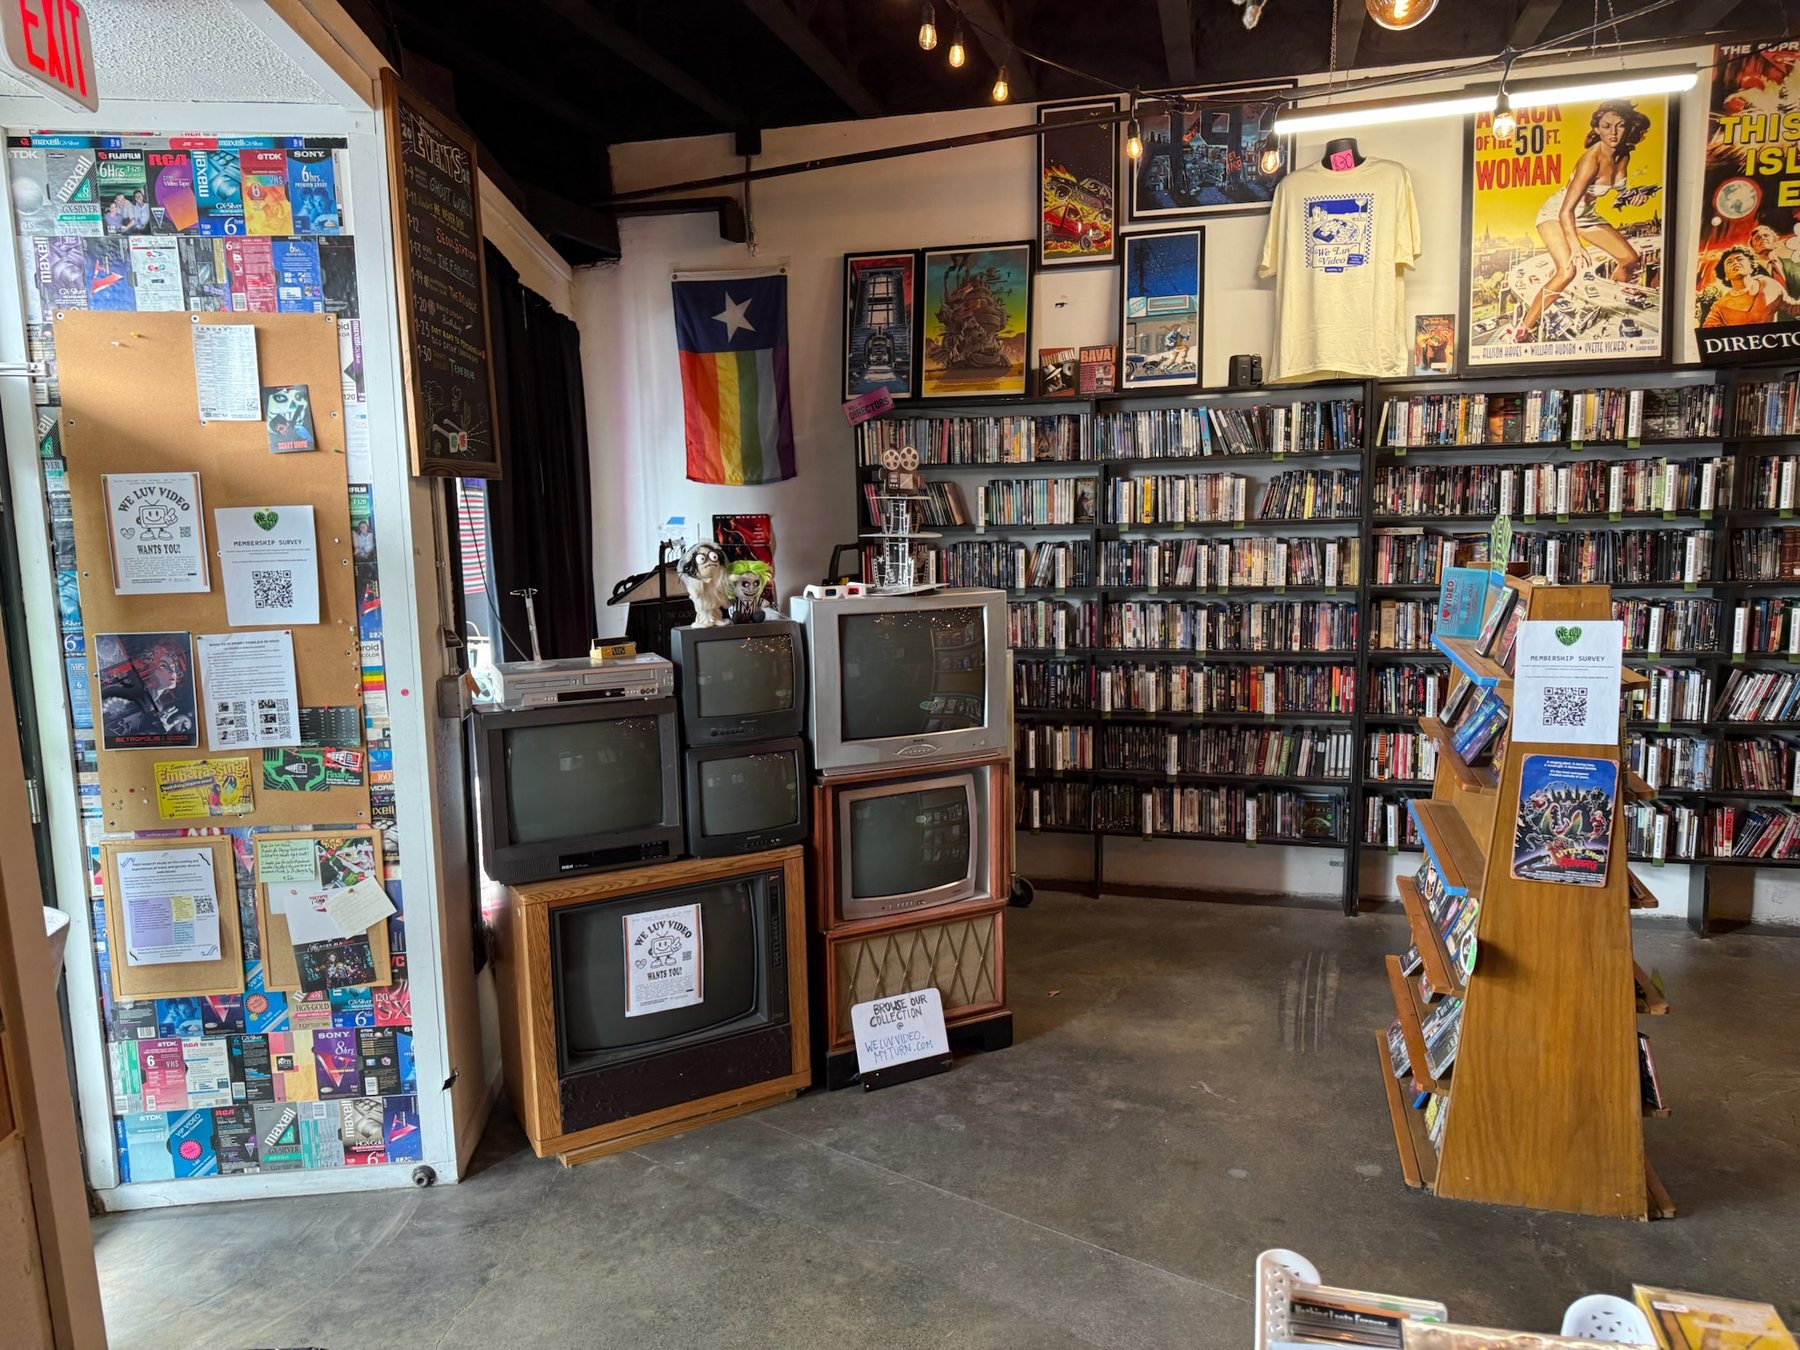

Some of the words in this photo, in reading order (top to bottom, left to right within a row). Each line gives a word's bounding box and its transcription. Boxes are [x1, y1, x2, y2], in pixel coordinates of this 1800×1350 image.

[19, 0, 87, 97] EXIT
[1721, 44, 1751, 55] THE
[1477, 104, 1561, 128] AACK
[1719, 112, 1800, 145] THIS
[32, 137, 59, 146] maxell
[218, 138, 244, 146] maxell
[410, 113, 463, 183] EVENTS
[1476, 136, 1490, 151] OF
[1515, 125, 1544, 155] 50
[1546, 129, 1560, 145] FT.
[11, 150, 37, 159] TDK
[108, 152, 141, 160] FUJIFILM
[148, 154, 187, 166] RCA
[57, 155, 92, 203] maxell
[193, 151, 209, 197] maxell
[1476, 154, 1561, 191] WOMAN
[224, 217, 237, 235] 6
[34, 237, 52, 283] maxell
[1705, 332, 1800, 355] DIRECTO
[1081, 349, 1111, 363] BAVA
[848, 397, 890, 420] DIRECTORS
[118, 494, 134, 513] WE
[133, 486, 156, 500] LUV
[159, 487, 191, 512] VIDEO
[137, 544, 162, 555] WANTS
[165, 543, 181, 554] YOU!
[1444, 580, 1454, 609] VIDEO
[1556, 848, 1583, 858] LITTLE
[634, 931, 649, 948] WE
[647, 921, 666, 934] LUV
[668, 920, 692, 938] VIDEO
[647, 970, 668, 981] WANTS
[669, 966, 682, 977] YOU!
[873, 998, 908, 1016] BROWSE
[910, 994, 928, 1006] OUR
[355, 1011, 366, 1026] 6
[869, 1006, 922, 1028] COLLECTION
[897, 1022, 904, 1030] @
[146, 1055, 155, 1067] 6
[166, 1060, 179, 1068] VHS
[184, 1113, 202, 1130] VIDEO
[264, 1106, 296, 1147] maxell
[341, 1101, 354, 1138] maxell
